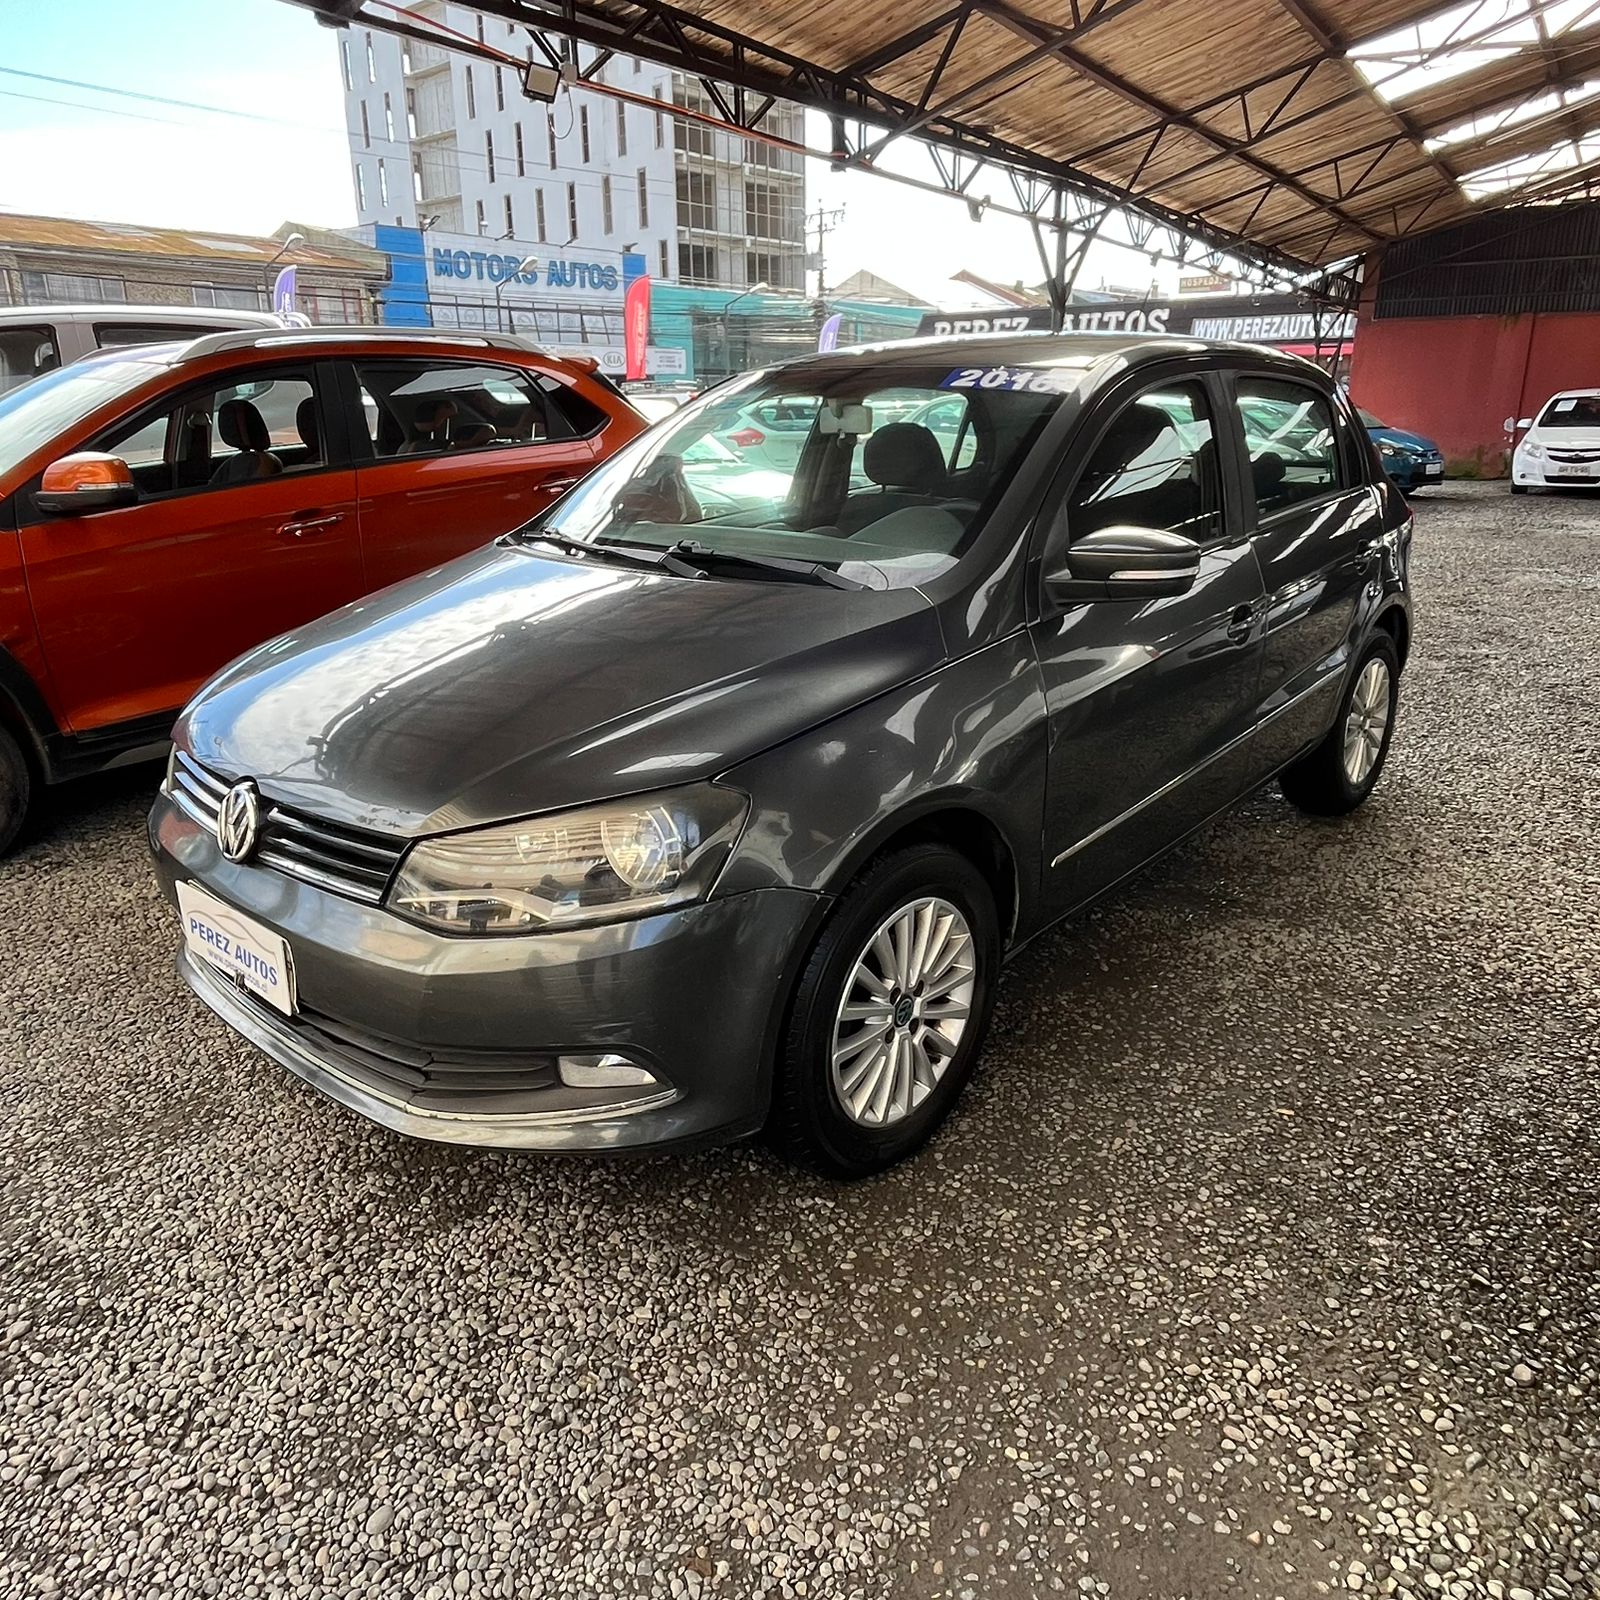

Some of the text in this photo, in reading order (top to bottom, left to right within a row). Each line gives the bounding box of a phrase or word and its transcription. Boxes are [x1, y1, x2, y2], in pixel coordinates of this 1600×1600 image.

[433, 248, 618, 290] MOTORS AUTOS
[606, 355, 622, 365] KIA
[950, 369, 1054, 393] 2016
[190, 918, 278, 986] PEREZ AUTOS
